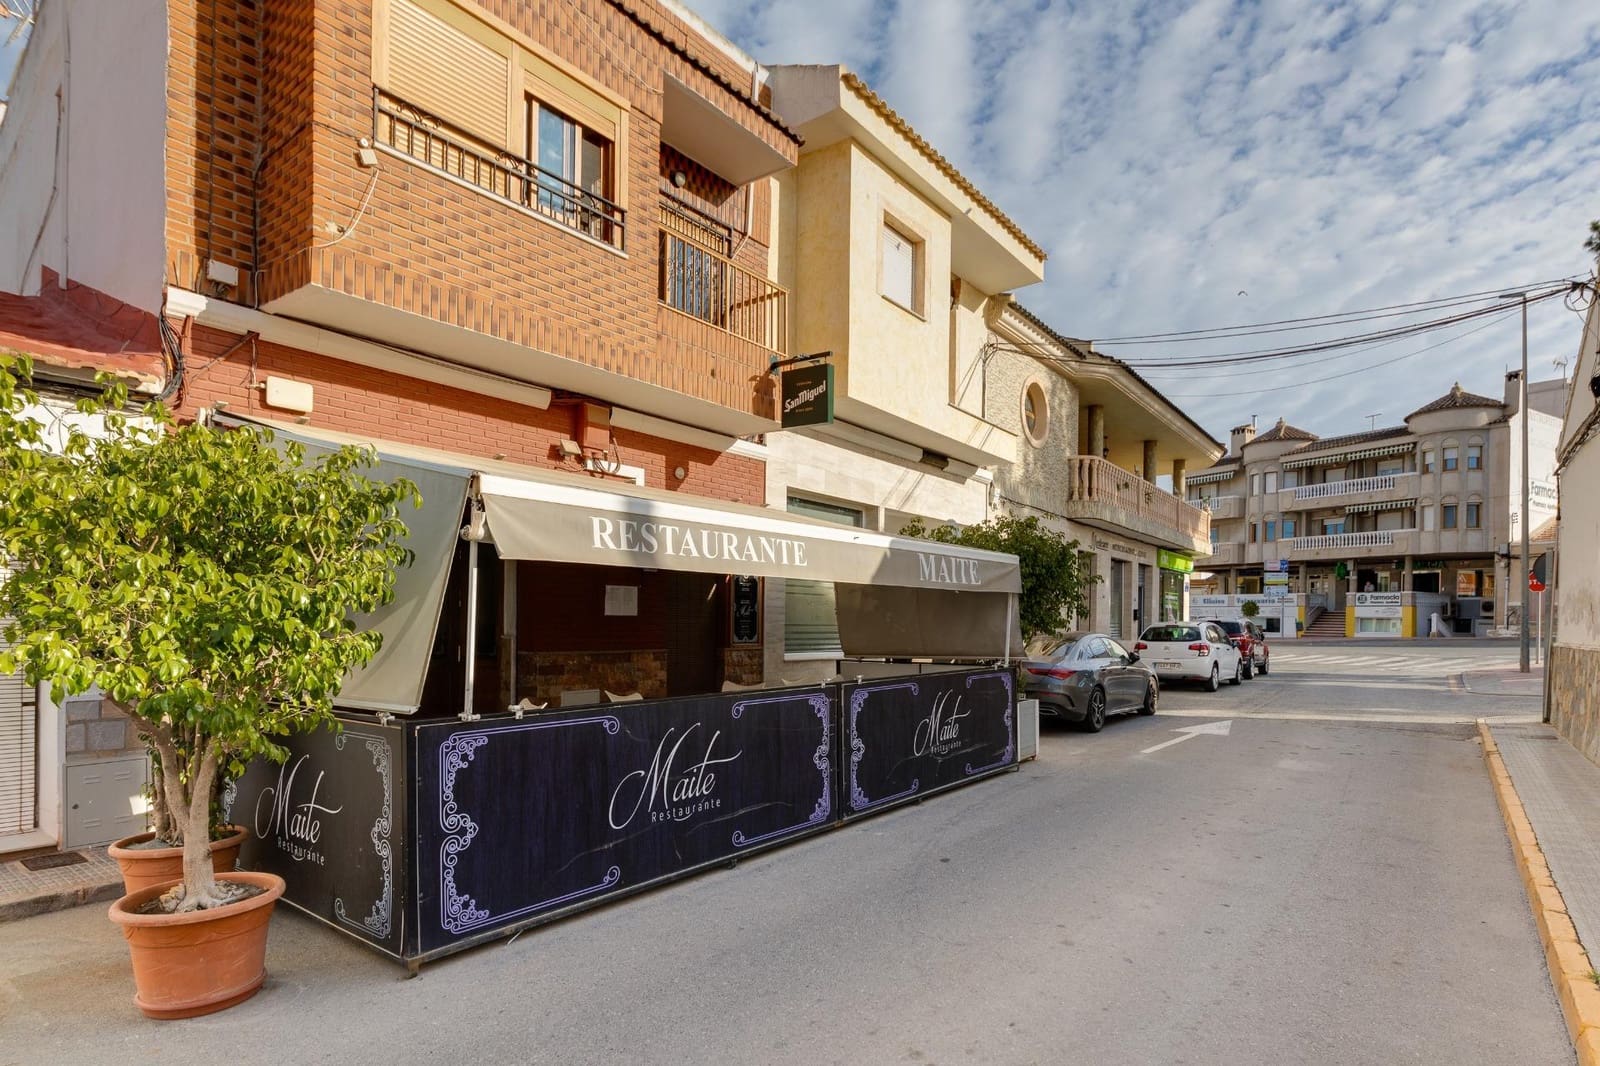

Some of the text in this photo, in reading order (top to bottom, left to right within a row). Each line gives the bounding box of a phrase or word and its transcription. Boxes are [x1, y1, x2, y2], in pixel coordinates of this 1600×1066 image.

[590, 516, 982, 586] RESTAURANTE MAITE
[914, 689, 971, 757] Maite
[255, 752, 343, 843] Maite
[609, 722, 742, 829] Maite
